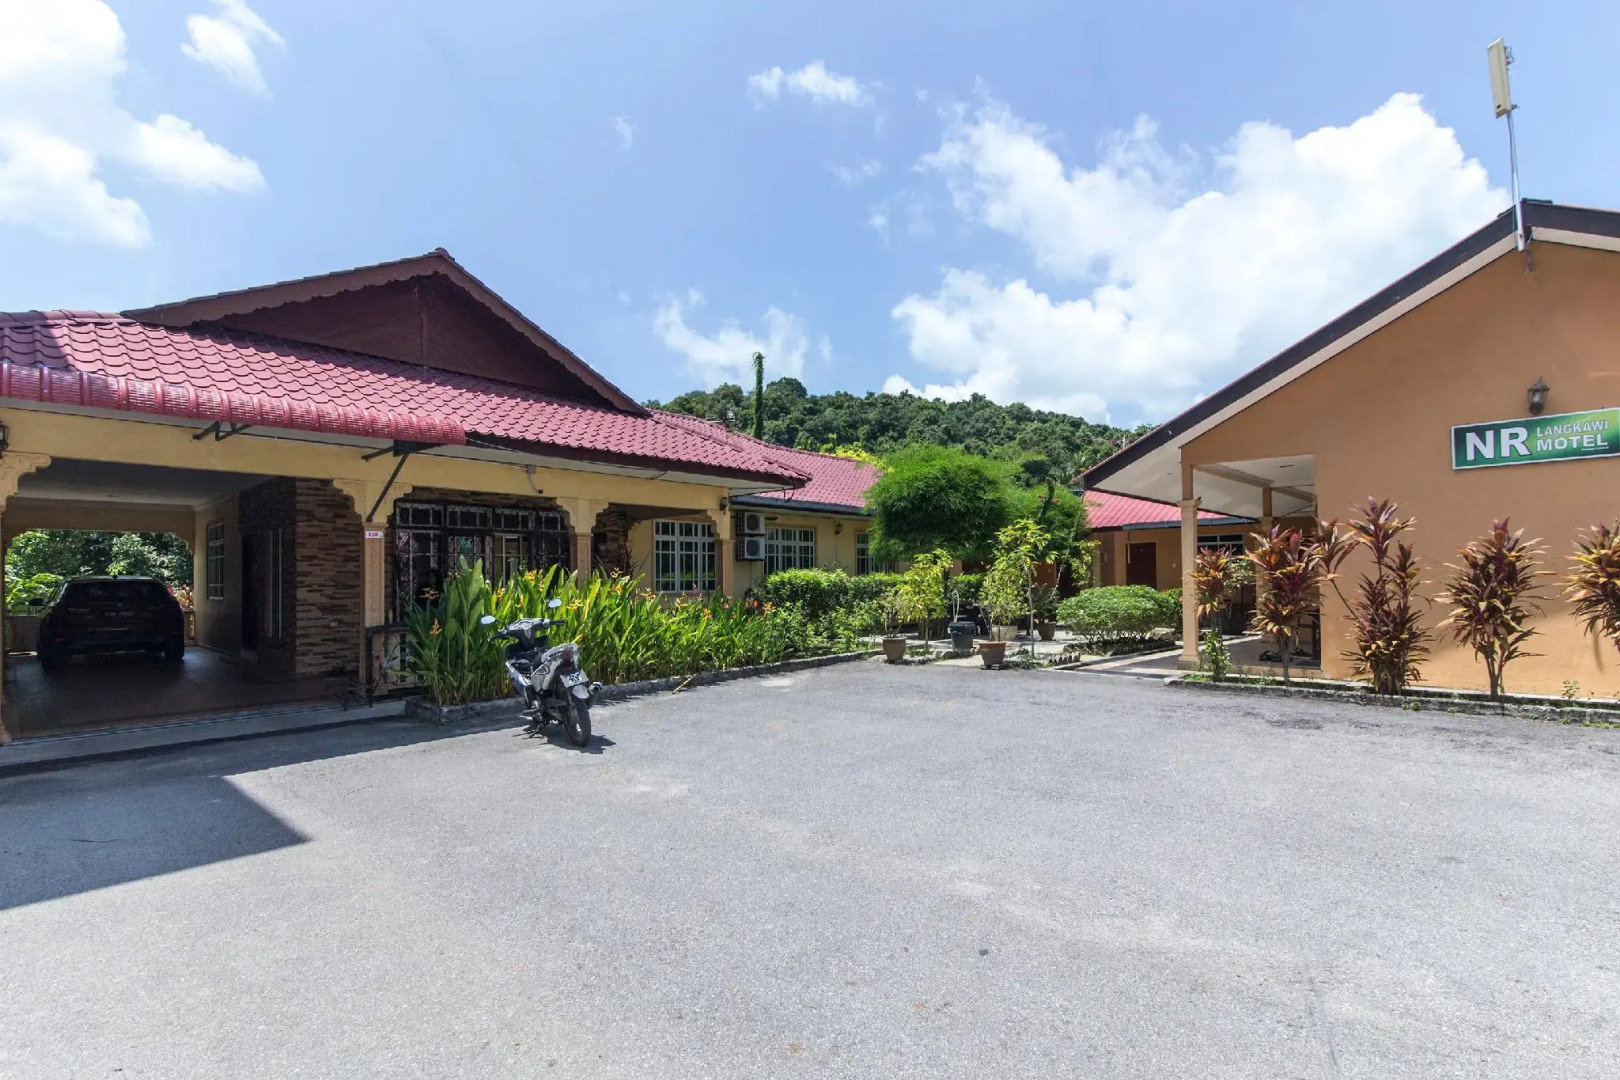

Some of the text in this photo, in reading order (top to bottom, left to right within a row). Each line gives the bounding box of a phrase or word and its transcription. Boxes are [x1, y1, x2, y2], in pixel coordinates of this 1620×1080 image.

[1536, 420, 1608, 437] LANGKAWI
[1465, 426, 1531, 461] NR
[1536, 433, 1608, 451] MOTEL
